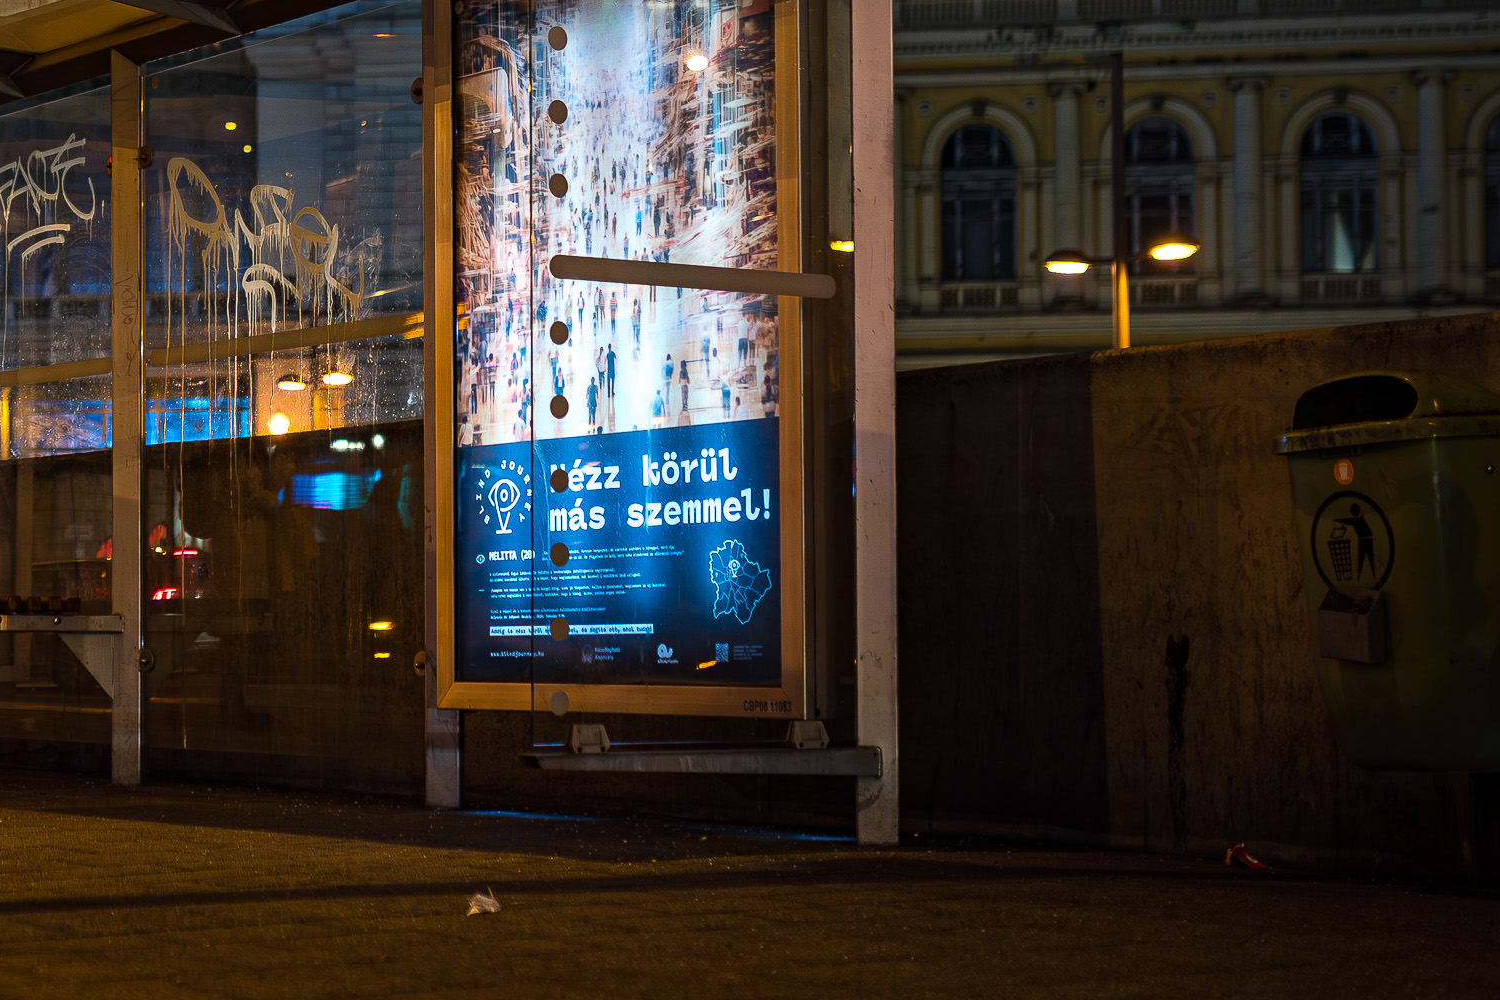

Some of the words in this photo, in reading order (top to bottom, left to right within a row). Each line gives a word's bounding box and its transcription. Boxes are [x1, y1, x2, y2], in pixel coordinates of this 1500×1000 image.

[642, 447, 738, 487] körül
[549, 497, 605, 532] más
[626, 488, 771, 528] szemmel!
[488, 550, 518, 561] MELITTA
